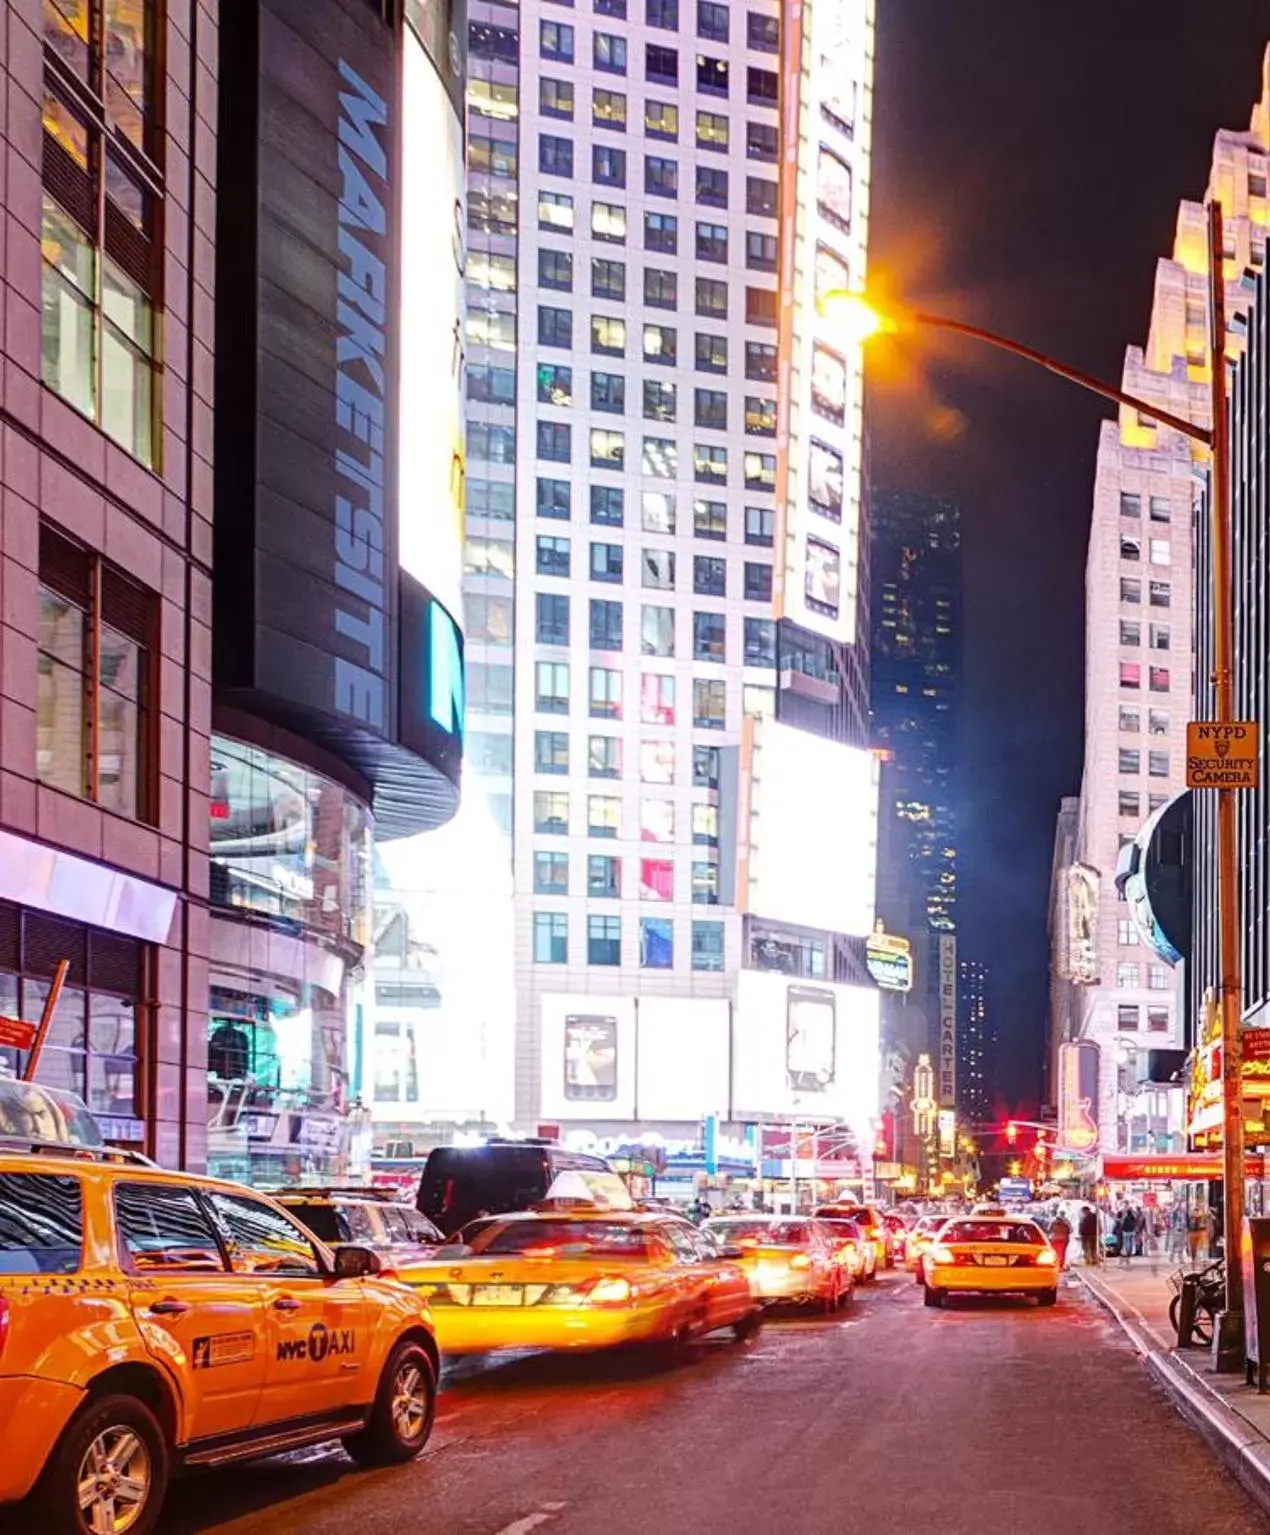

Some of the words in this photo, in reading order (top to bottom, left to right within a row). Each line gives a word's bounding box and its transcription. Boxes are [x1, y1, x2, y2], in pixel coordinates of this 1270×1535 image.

[334, 58, 388, 732] MARKETSITE
[1198, 726, 1247, 739] NYPD
[941, 938, 955, 1010] HOTEL
[941, 1015, 955, 1096] CARTER
[276, 1340, 307, 1361] NYC
[308, 1322, 355, 1362] TAXI
